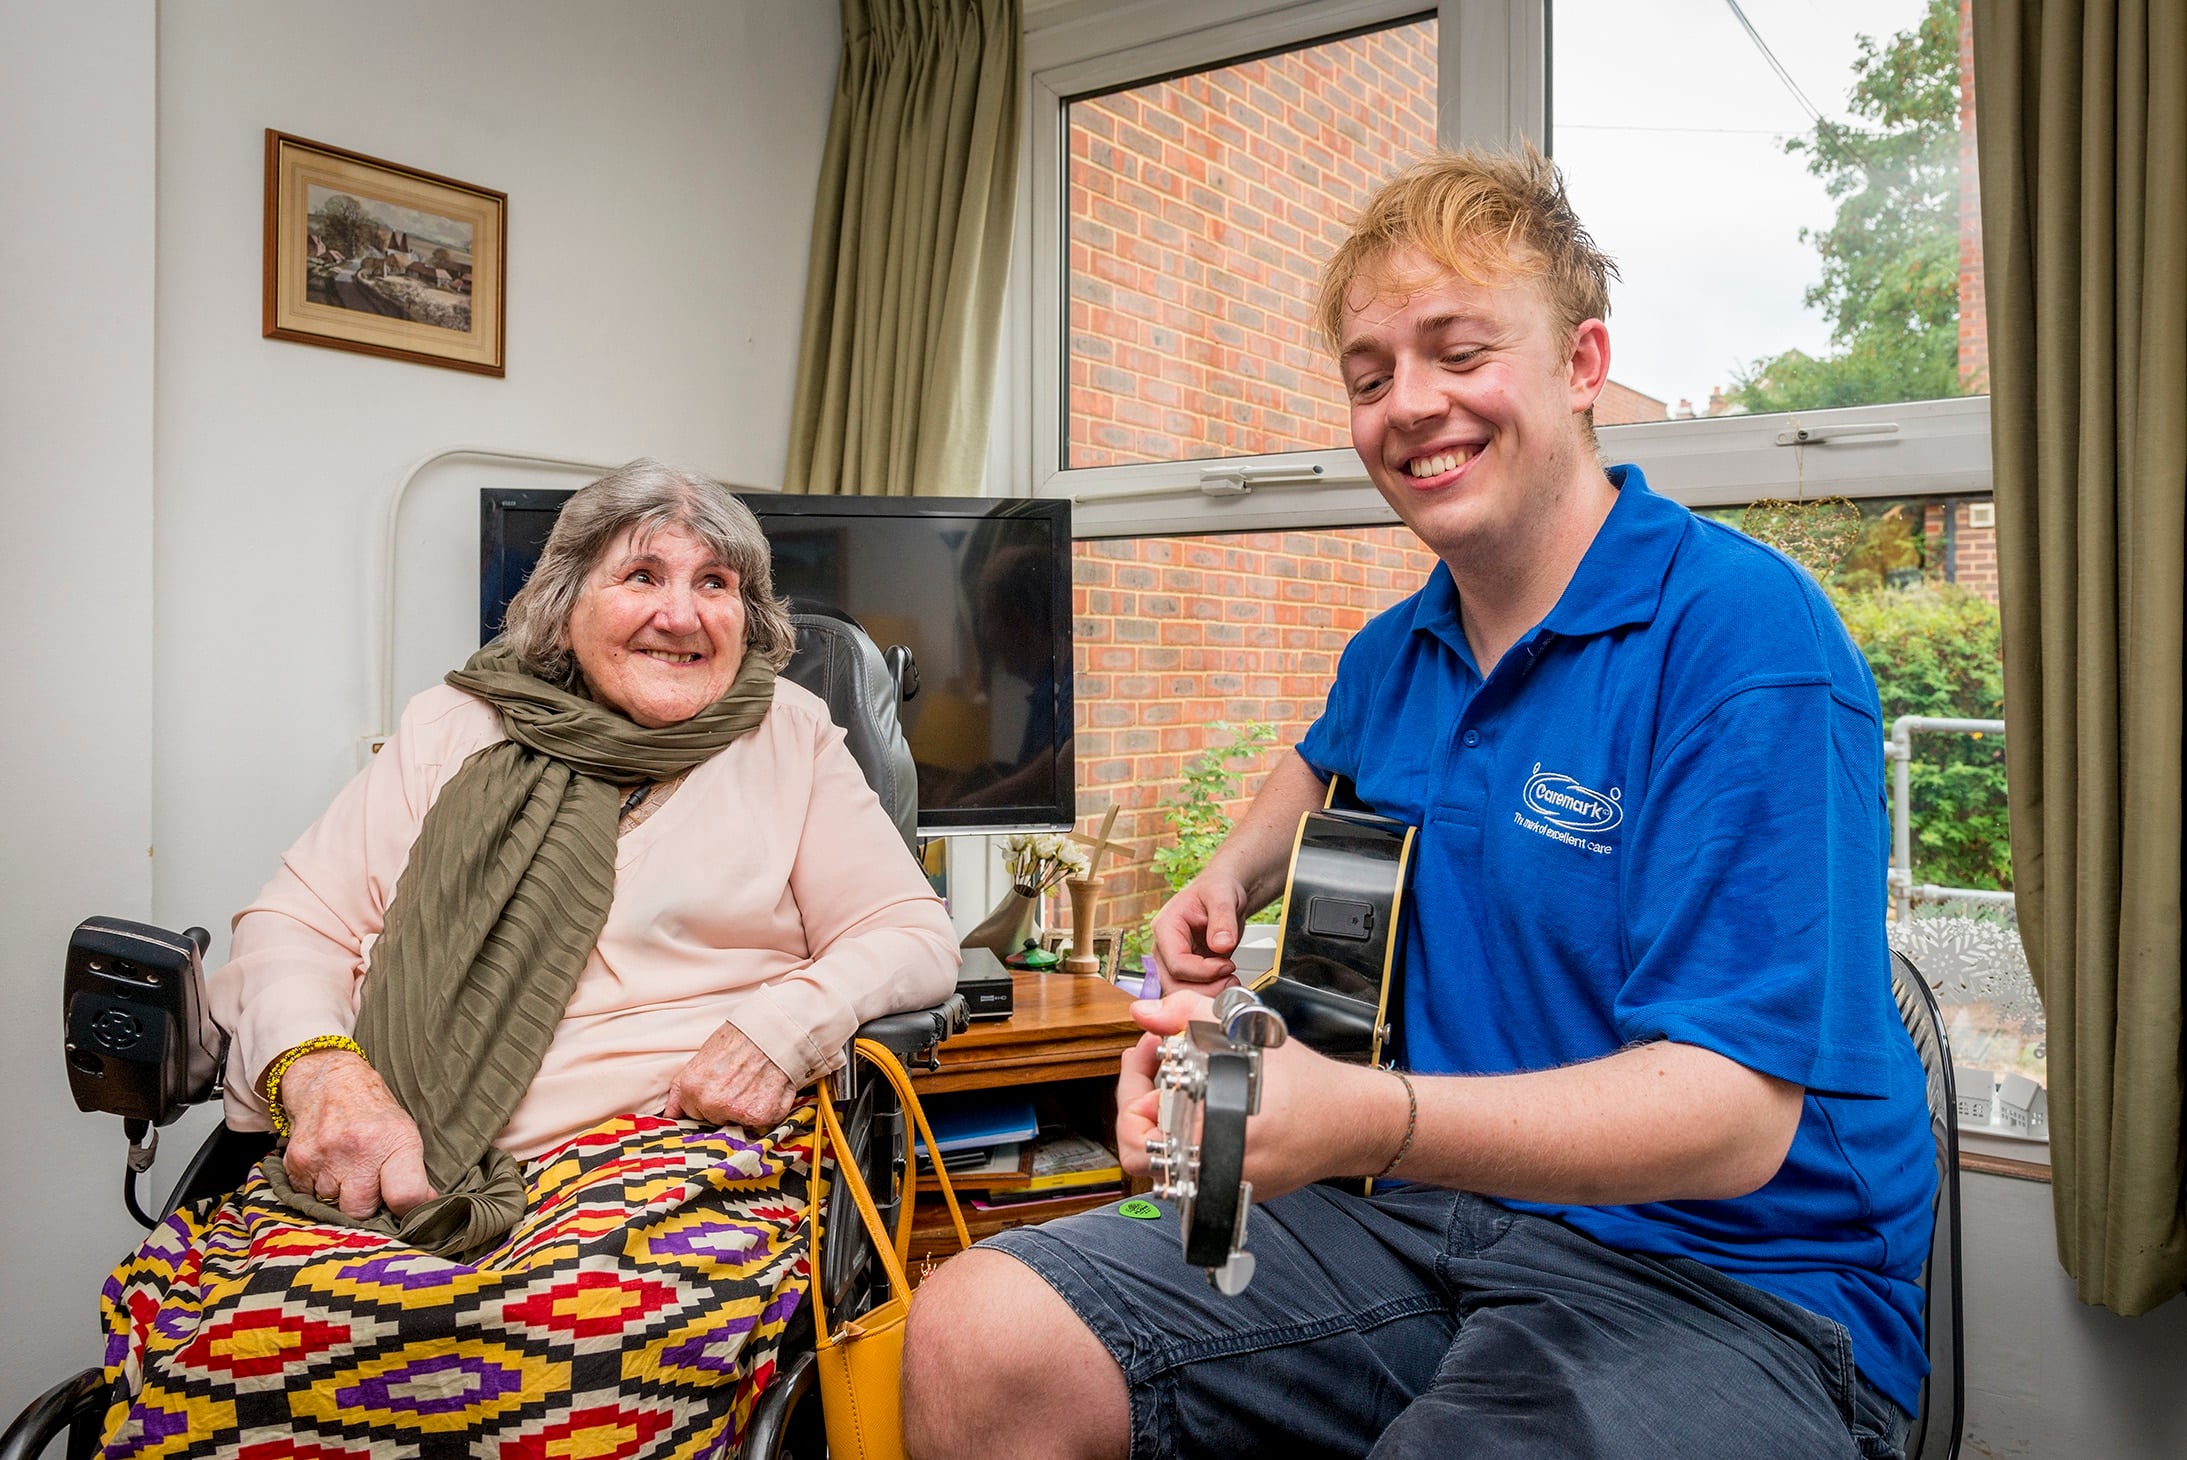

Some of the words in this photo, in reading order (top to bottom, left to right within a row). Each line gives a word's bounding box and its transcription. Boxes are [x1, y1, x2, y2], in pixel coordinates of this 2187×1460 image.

[1536, 784, 1603, 820] Caremark
[1546, 828, 1586, 849] excellent
[1587, 841, 1613, 855] care
